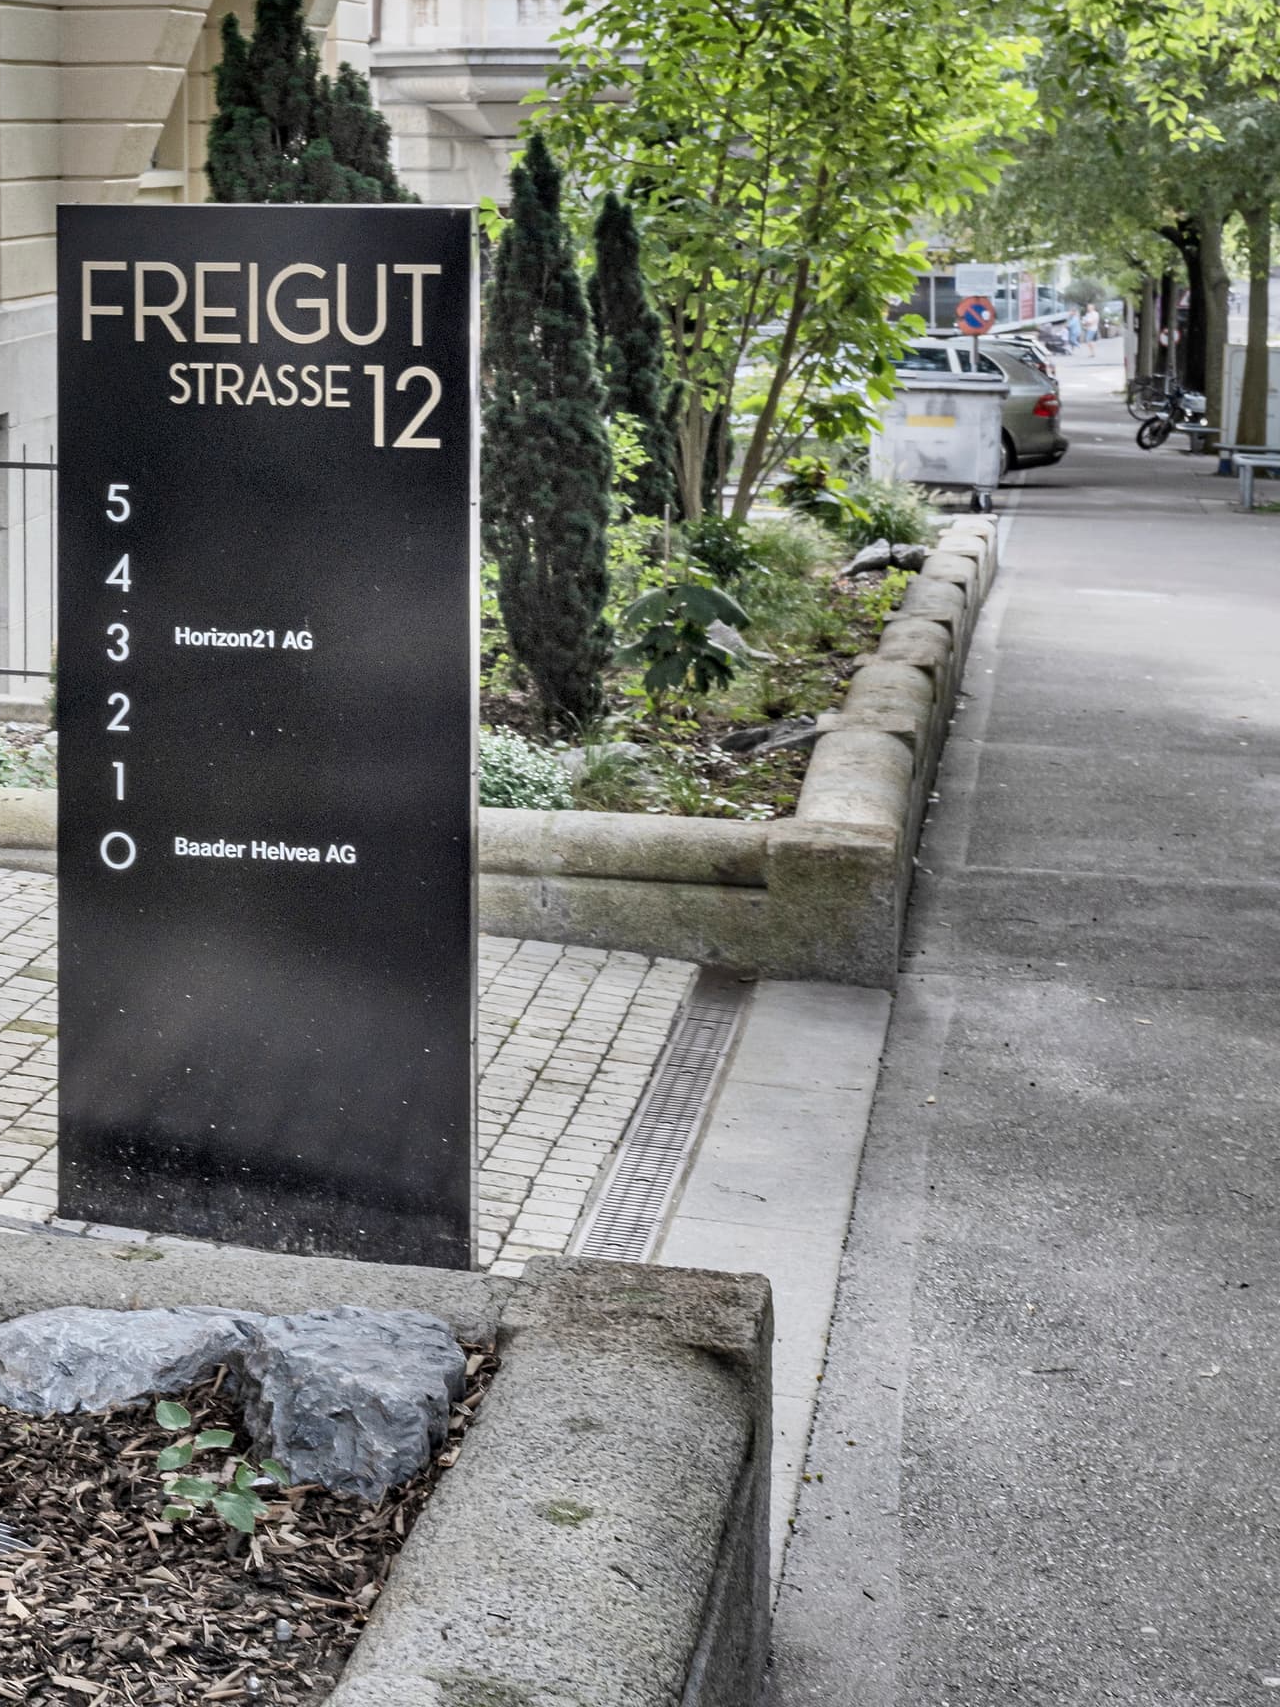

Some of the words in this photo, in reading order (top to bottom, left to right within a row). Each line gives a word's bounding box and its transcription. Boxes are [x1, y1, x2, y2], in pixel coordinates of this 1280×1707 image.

[82, 260, 442, 347] FREIGUT
[169, 362, 351, 408] STRASSE
[364, 364, 442, 449] 12
[106, 483, 131, 523] 5
[105, 553, 133, 593] 4
[106, 623, 130, 663] 3
[174, 626, 276, 650] Horizon21
[282, 629, 314, 651] AG
[106, 692, 131, 732] 2
[112, 761, 125, 801] 1
[174, 836, 248, 860] Baader
[251, 840, 321, 863] Helvea
[325, 844, 357, 865] AG
